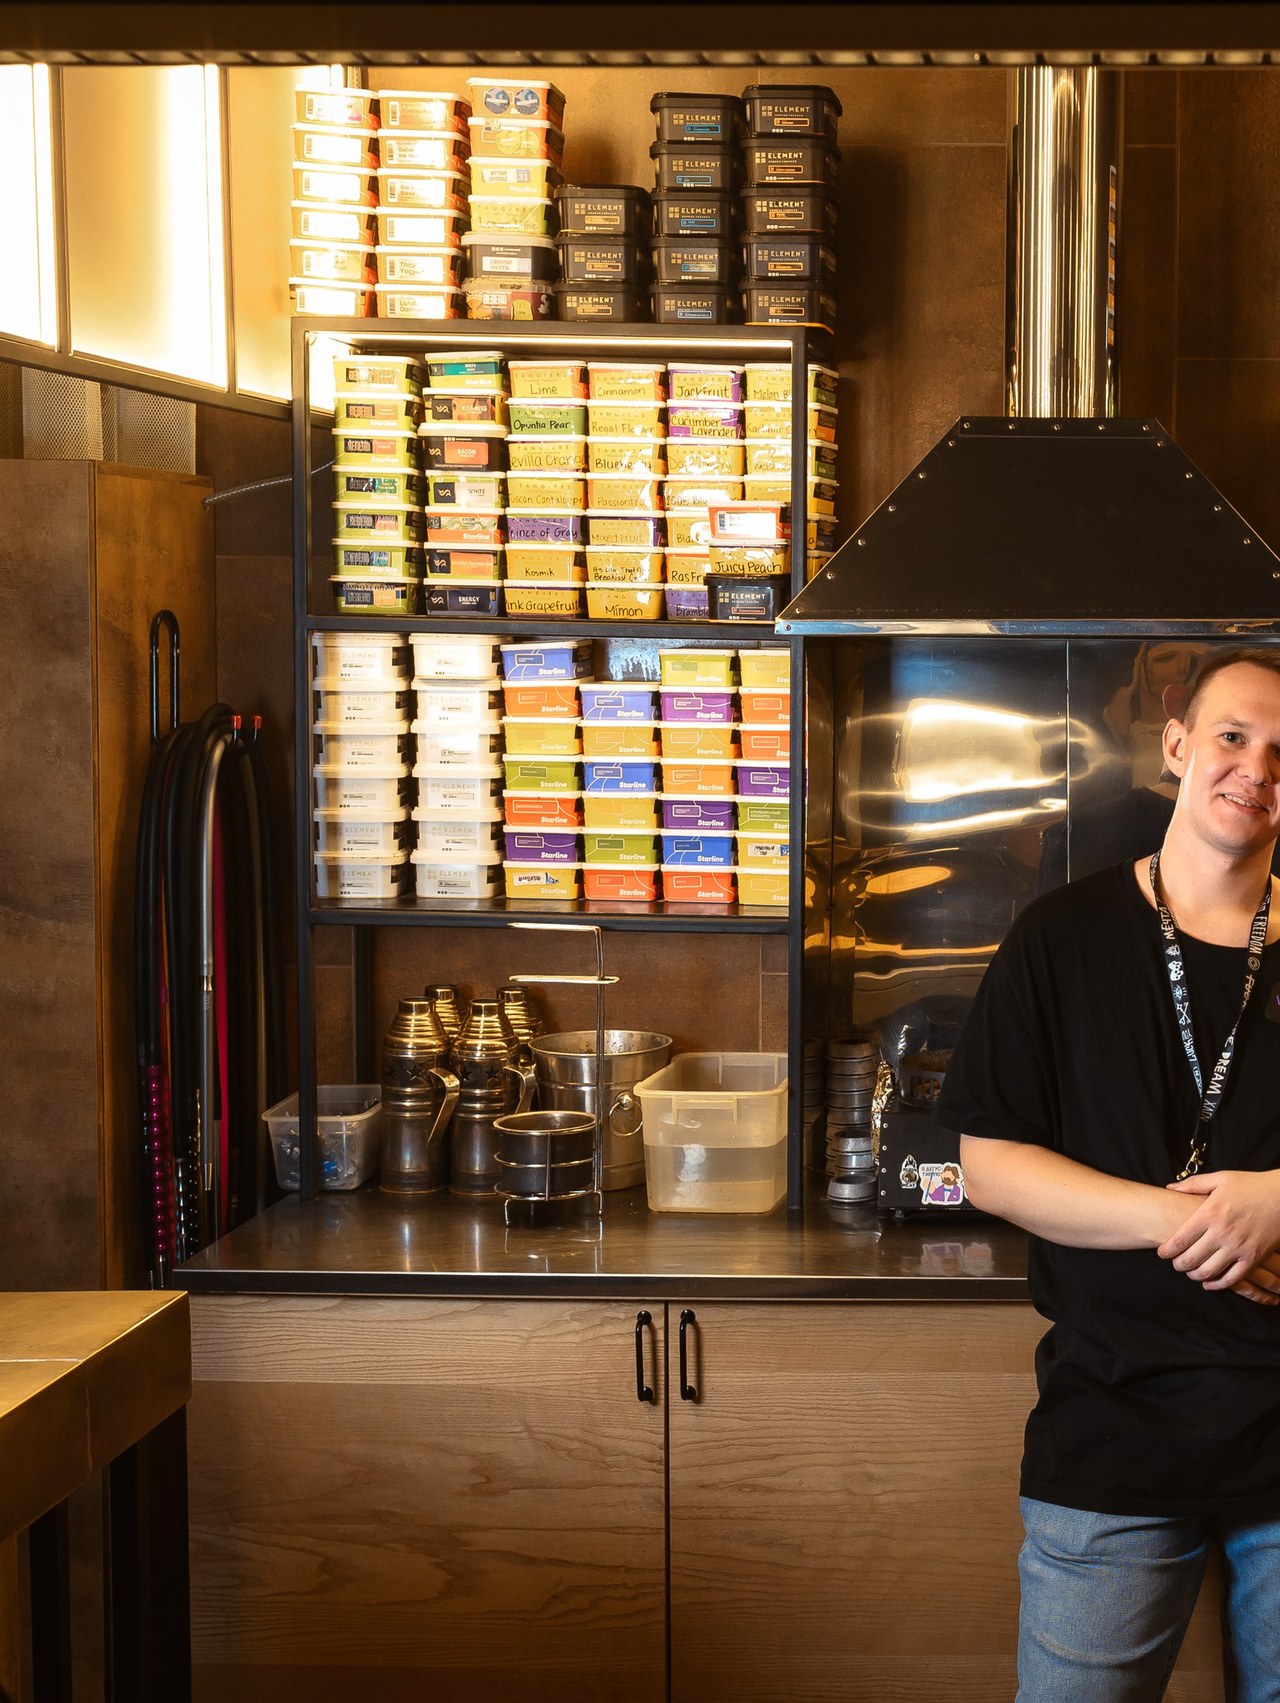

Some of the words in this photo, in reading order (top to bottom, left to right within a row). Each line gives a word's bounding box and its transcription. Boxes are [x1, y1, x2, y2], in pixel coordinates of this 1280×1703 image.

[579, 296, 614, 304] ELEMENT
[530, 383, 558, 395] Lime
[597, 386, 646, 397] Cinnamon
[513, 420, 546, 431] Opuntia
[550, 420, 570, 430] Pear
[671, 414, 721, 427] Cucumber
[692, 426, 736, 437] Lavender
[540, 527, 551, 538] of
[525, 567, 555, 577] Kosmik
[714, 562, 745, 574] Juicy
[747, 561, 782, 573] Peach
[526, 600, 579, 613] Grapefruit
[538, 668, 566, 676] Starline
[697, 819, 725, 827] Starline
[697, 890, 724, 898] Starline
[1159, 906, 1176, 940] МЕЧТА
[1250, 916, 1268, 954] FREEDOM
[1206, 1052, 1231, 1094] DREAM
